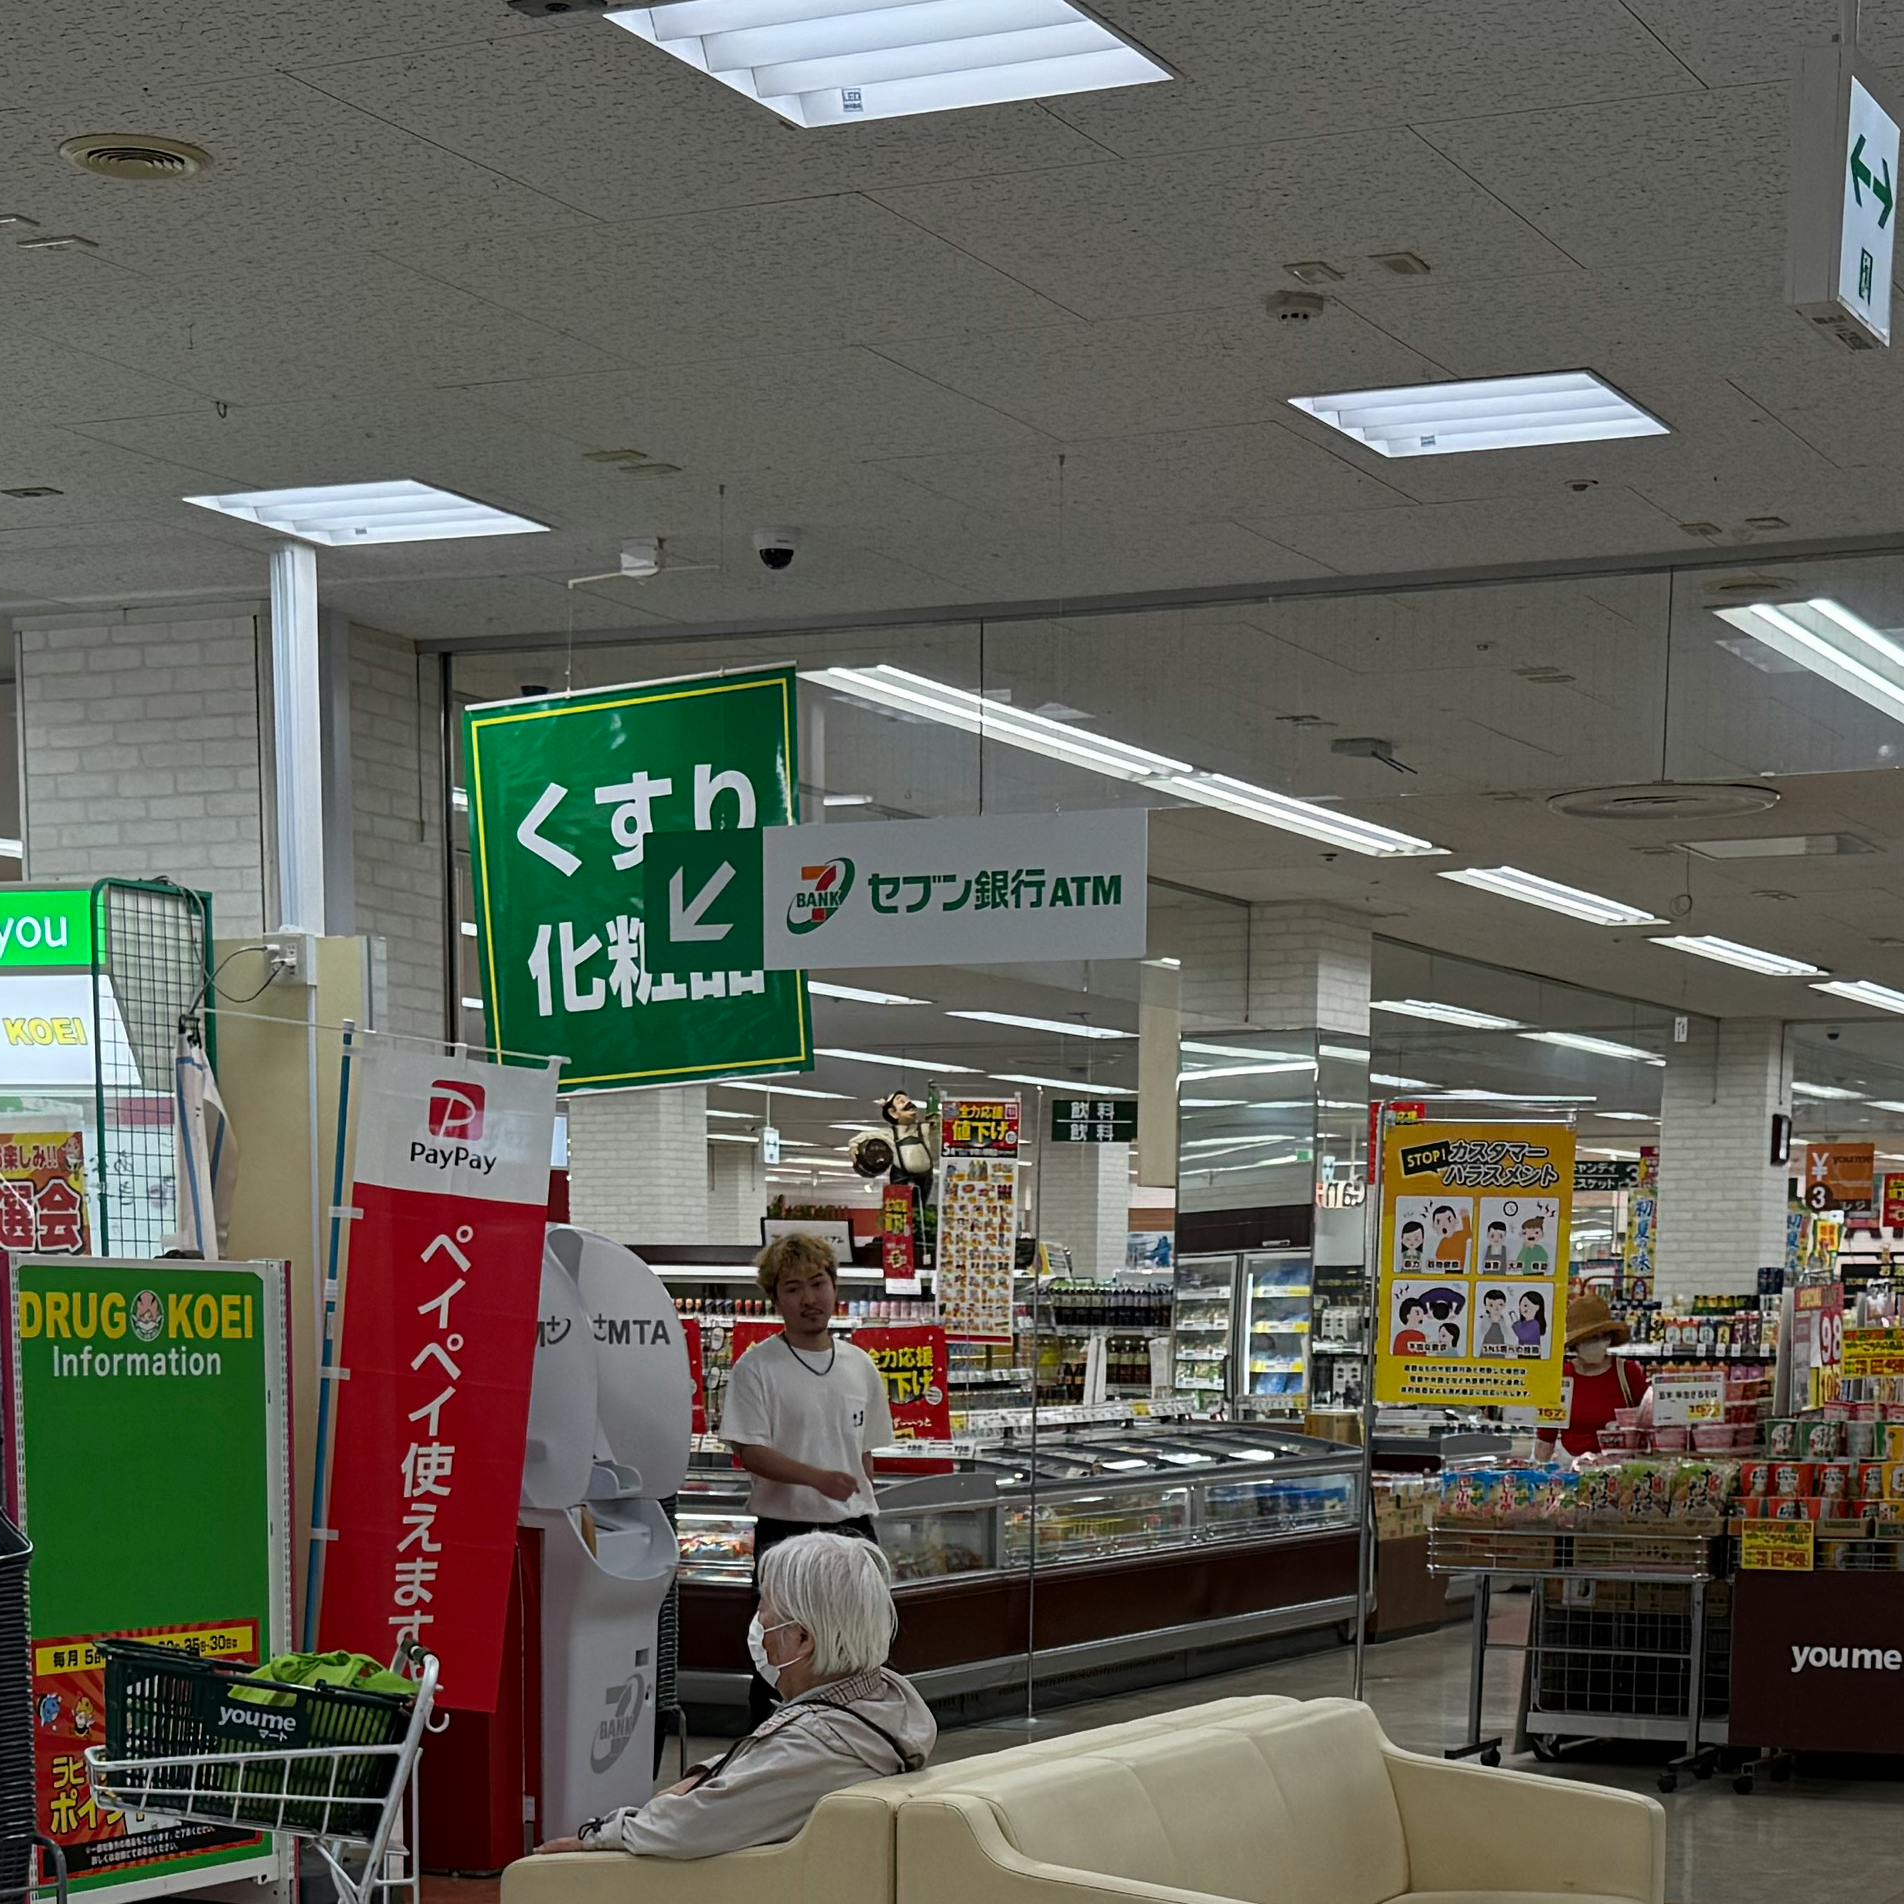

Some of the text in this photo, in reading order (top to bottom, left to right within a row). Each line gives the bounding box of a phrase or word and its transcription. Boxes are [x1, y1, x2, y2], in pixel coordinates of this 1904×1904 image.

[517, 764, 756, 879] くすり
[796, 891, 843, 909] BANK
[7, 1016, 87, 1046] KOEI
[959, 1105, 1003, 1119] 全力応援
[1070, 1101, 1114, 1121] 飲料
[952, 1120, 1008, 1143] 値下げ
[1070, 1123, 1114, 1142] 飲料
[410, 1142, 497, 1176] PayPay
[1407, 1147, 1445, 1168] STOP!
[1448, 1141, 1549, 1163] カスタマー
[1444, 1163, 1559, 1188] ハラスメント
[1574, 1179, 1615, 1189] スケット
[1811, 1187, 1826, 1209] 3
[19, 1291, 254, 1339] DRUG KOEI
[52, 1345, 223, 1378] Information
[53, 1650, 79, 1669] 毎月
[1791, 1644, 1904, 1673] youme
[218, 1704, 296, 1733] youme
